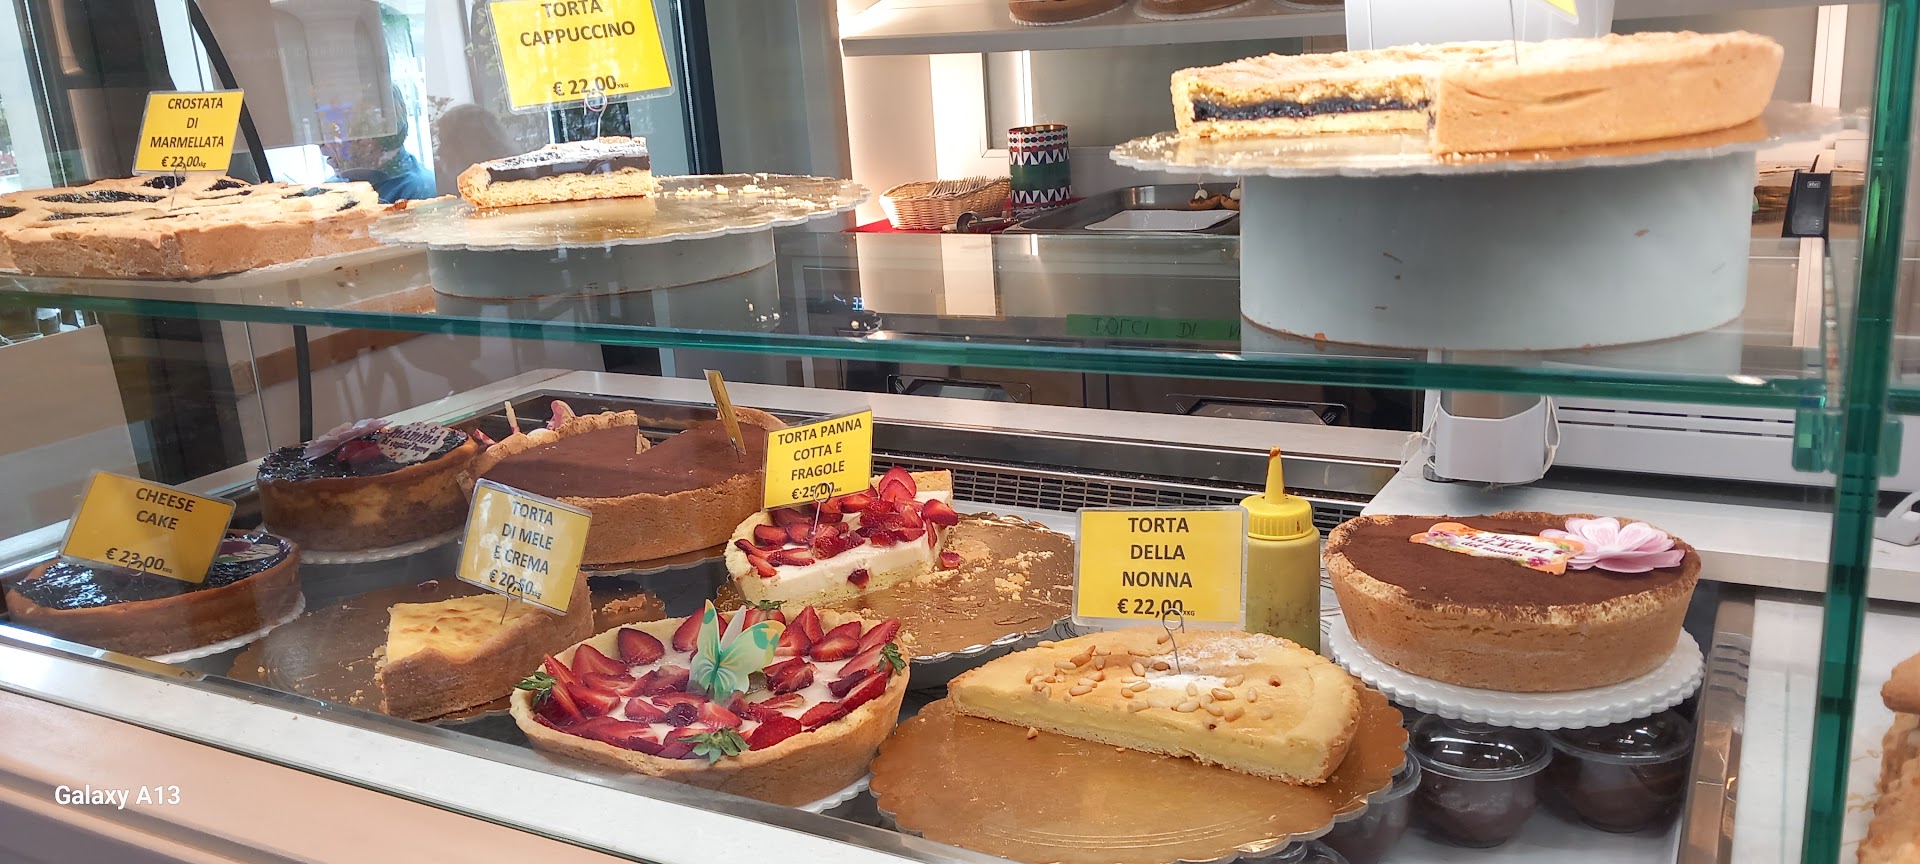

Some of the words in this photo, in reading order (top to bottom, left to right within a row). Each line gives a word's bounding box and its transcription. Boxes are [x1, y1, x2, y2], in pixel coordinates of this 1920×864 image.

[540, 0, 603, 18] TORTA
[520, 20, 635, 47] CAPPUCCINO
[552, 81, 565, 96] €
[167, 97, 223, 110] CROSTATA
[186, 117, 199, 129] DI
[150, 136, 224, 148] MARMELLATA
[161, 156, 169, 168] €
[777, 428, 818, 445] TORTA
[820, 418, 862, 437] PANNA
[793, 444, 832, 461] COTTA
[835, 442, 843, 453] E
[791, 460, 845, 481] FRAGOLE
[135, 487, 196, 513] CHEESE
[136, 510, 179, 530] CAKE
[512, 501, 554, 526] TORTA
[1128, 517, 1190, 533] TORTA
[501, 523, 517, 539] DI
[518, 528, 554, 550] MELE
[105, 547, 118, 560] €
[493, 545, 502, 559] E
[504, 548, 549, 575] CREMA
[1130, 544, 1186, 560] DELLA
[489, 569, 498, 583] €
[1122, 571, 1193, 588] NONNA
[1117, 598, 1129, 614] €
